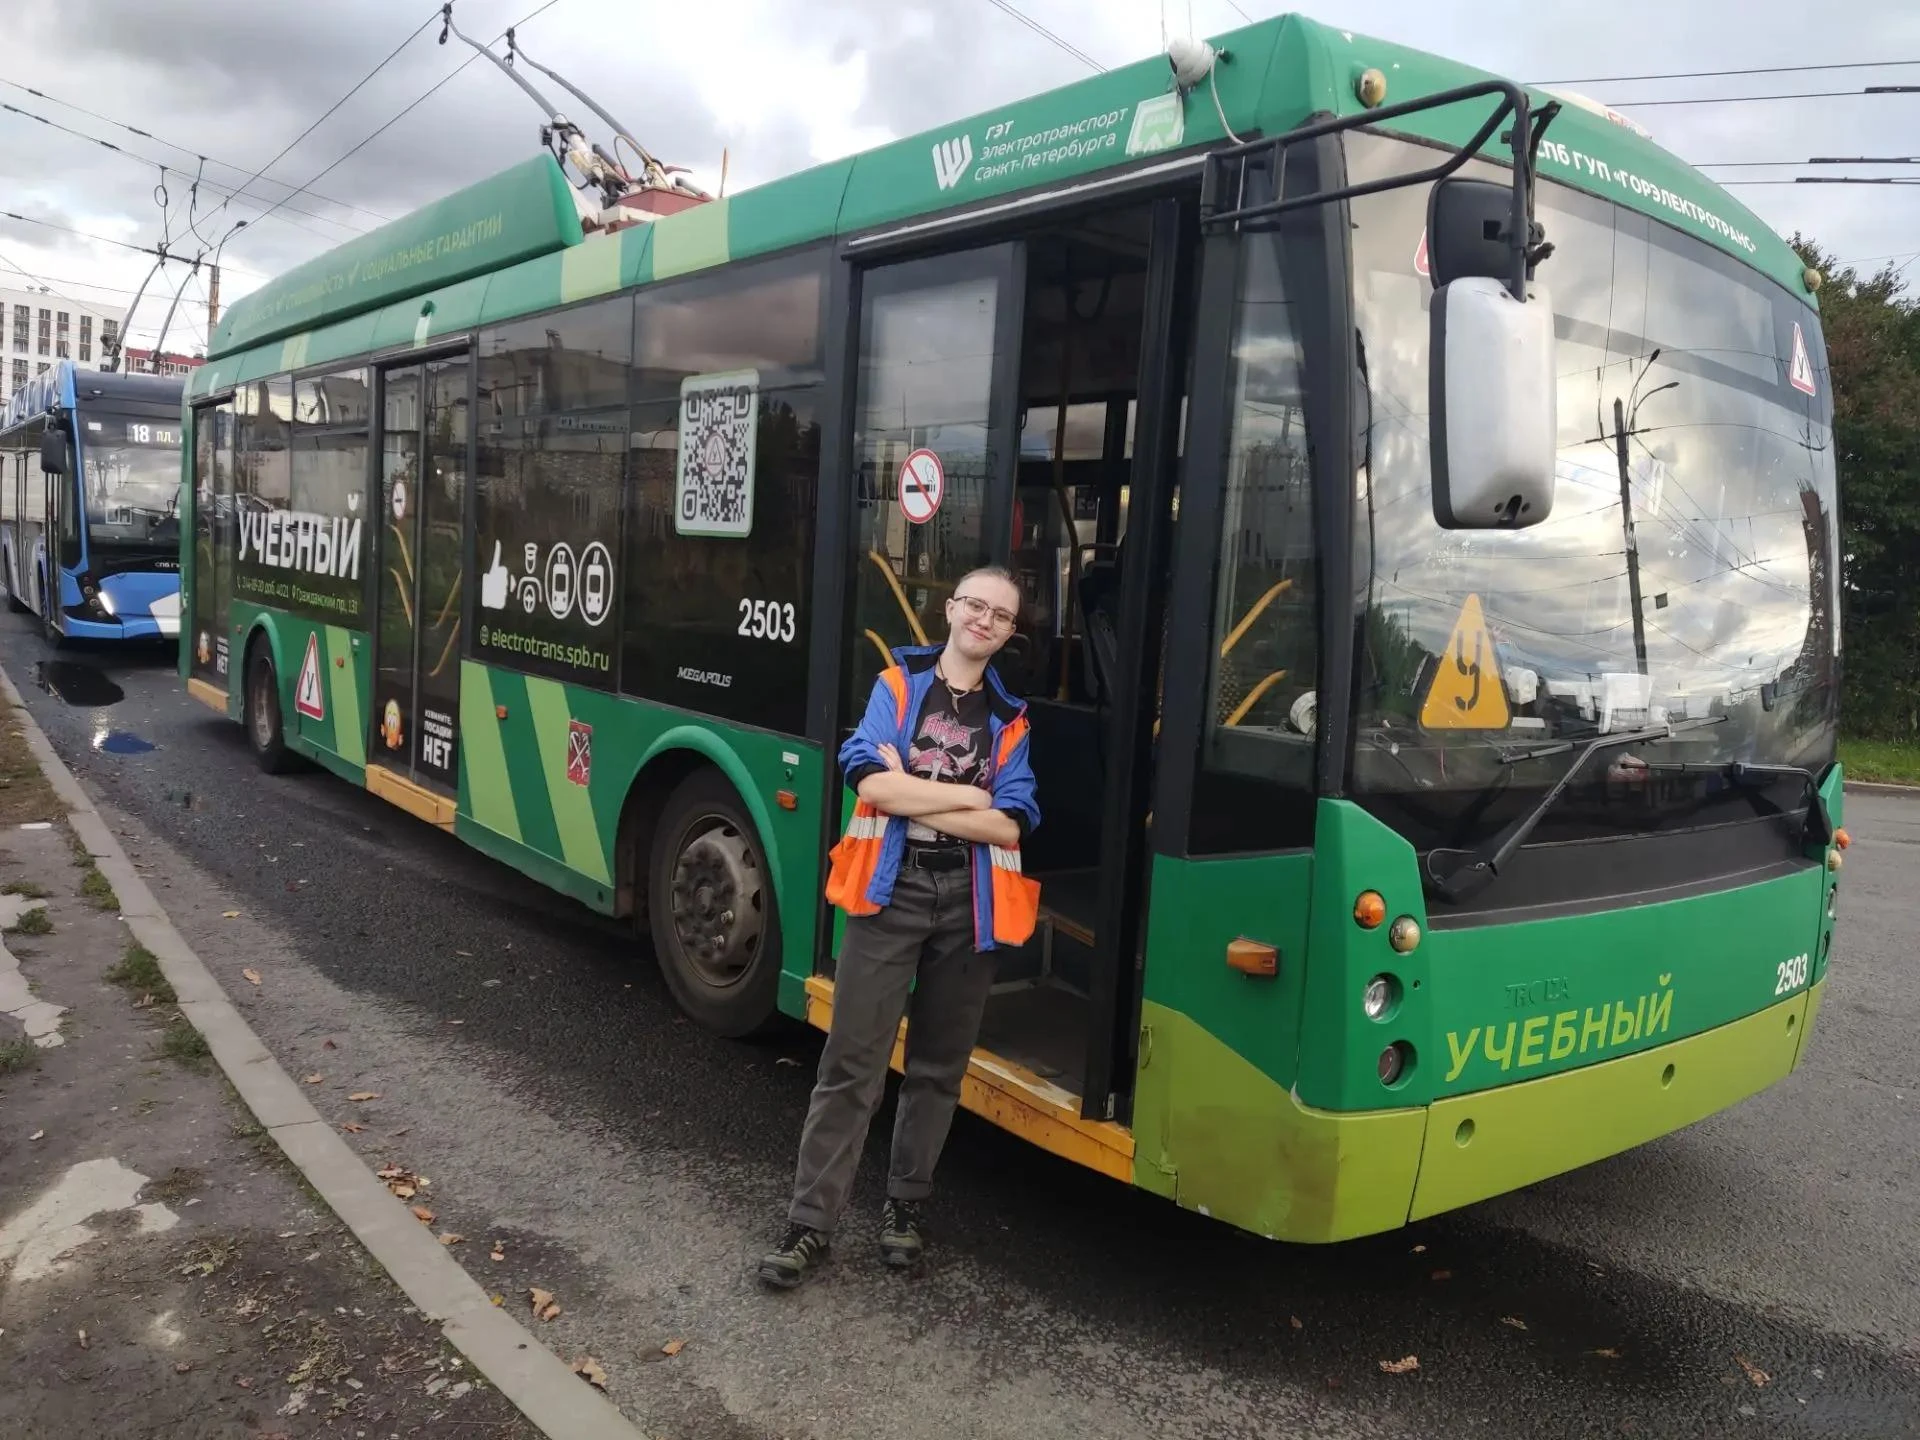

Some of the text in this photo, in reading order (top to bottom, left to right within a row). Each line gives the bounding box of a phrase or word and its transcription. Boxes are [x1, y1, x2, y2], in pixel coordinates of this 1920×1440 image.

[974, 132, 1116, 182] Санкт-Петербурга
[1573, 151, 1611, 182] ГУП
[435, 213, 503, 260] ГАРАНТИИ
[131, 424, 150, 443] 18
[238, 493, 361, 580] УЧЕБНЫЙ
[737, 597, 796, 643] 2503
[491, 629, 610, 671] electrotrans.spb.ru
[677, 666, 733, 687] MEGAPOLIS
[423, 734, 452, 770] НЕТ
[1774, 952, 1809, 996] 2503
[1444, 973, 1675, 1082] УЧЕБНЫЙ
